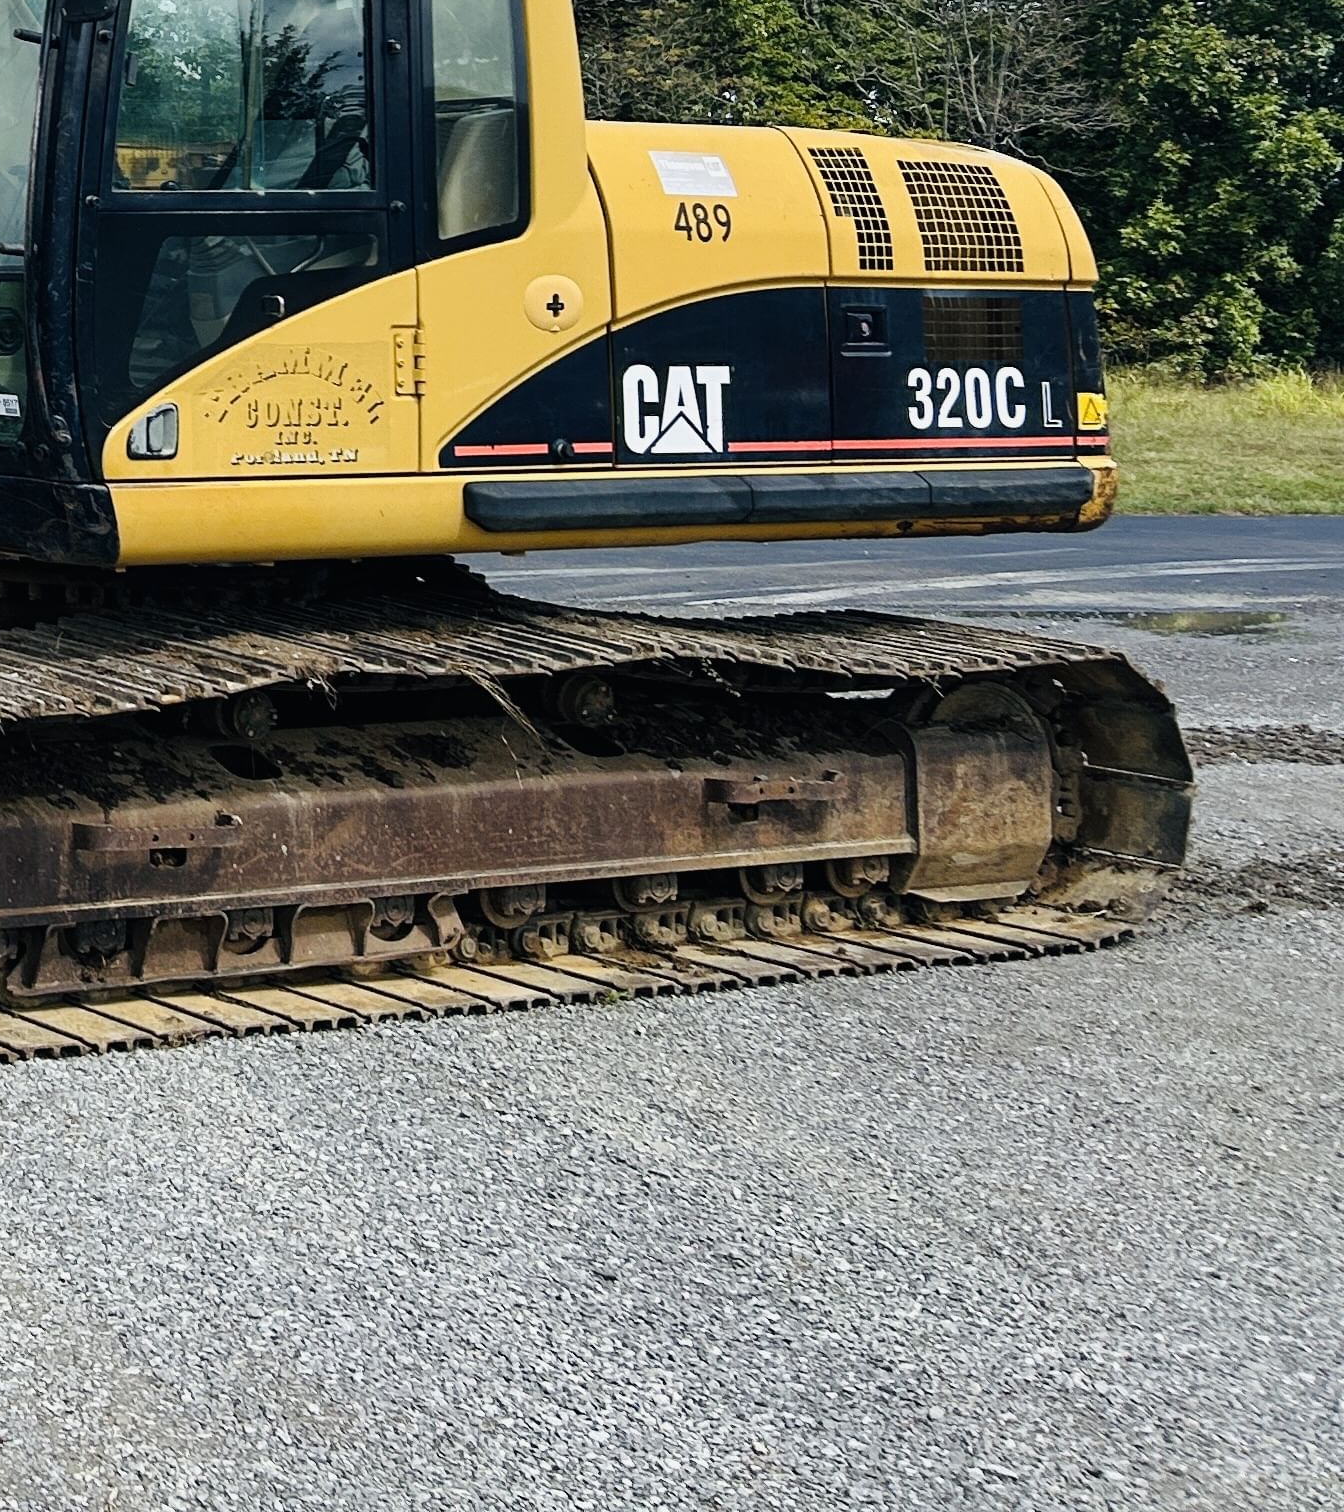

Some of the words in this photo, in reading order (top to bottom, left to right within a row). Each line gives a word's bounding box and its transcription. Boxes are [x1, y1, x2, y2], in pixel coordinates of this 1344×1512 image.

[674, 201, 731, 242] 489
[245, 397, 349, 428] CONST.
[623, 364, 731, 454] CAT
[907, 366, 1026, 430] 320C
[1041, 381, 1062, 428] L
[274, 431, 318, 445] INC.
[230, 448, 325, 465] Porland,
[329, 448, 359, 463] TN
